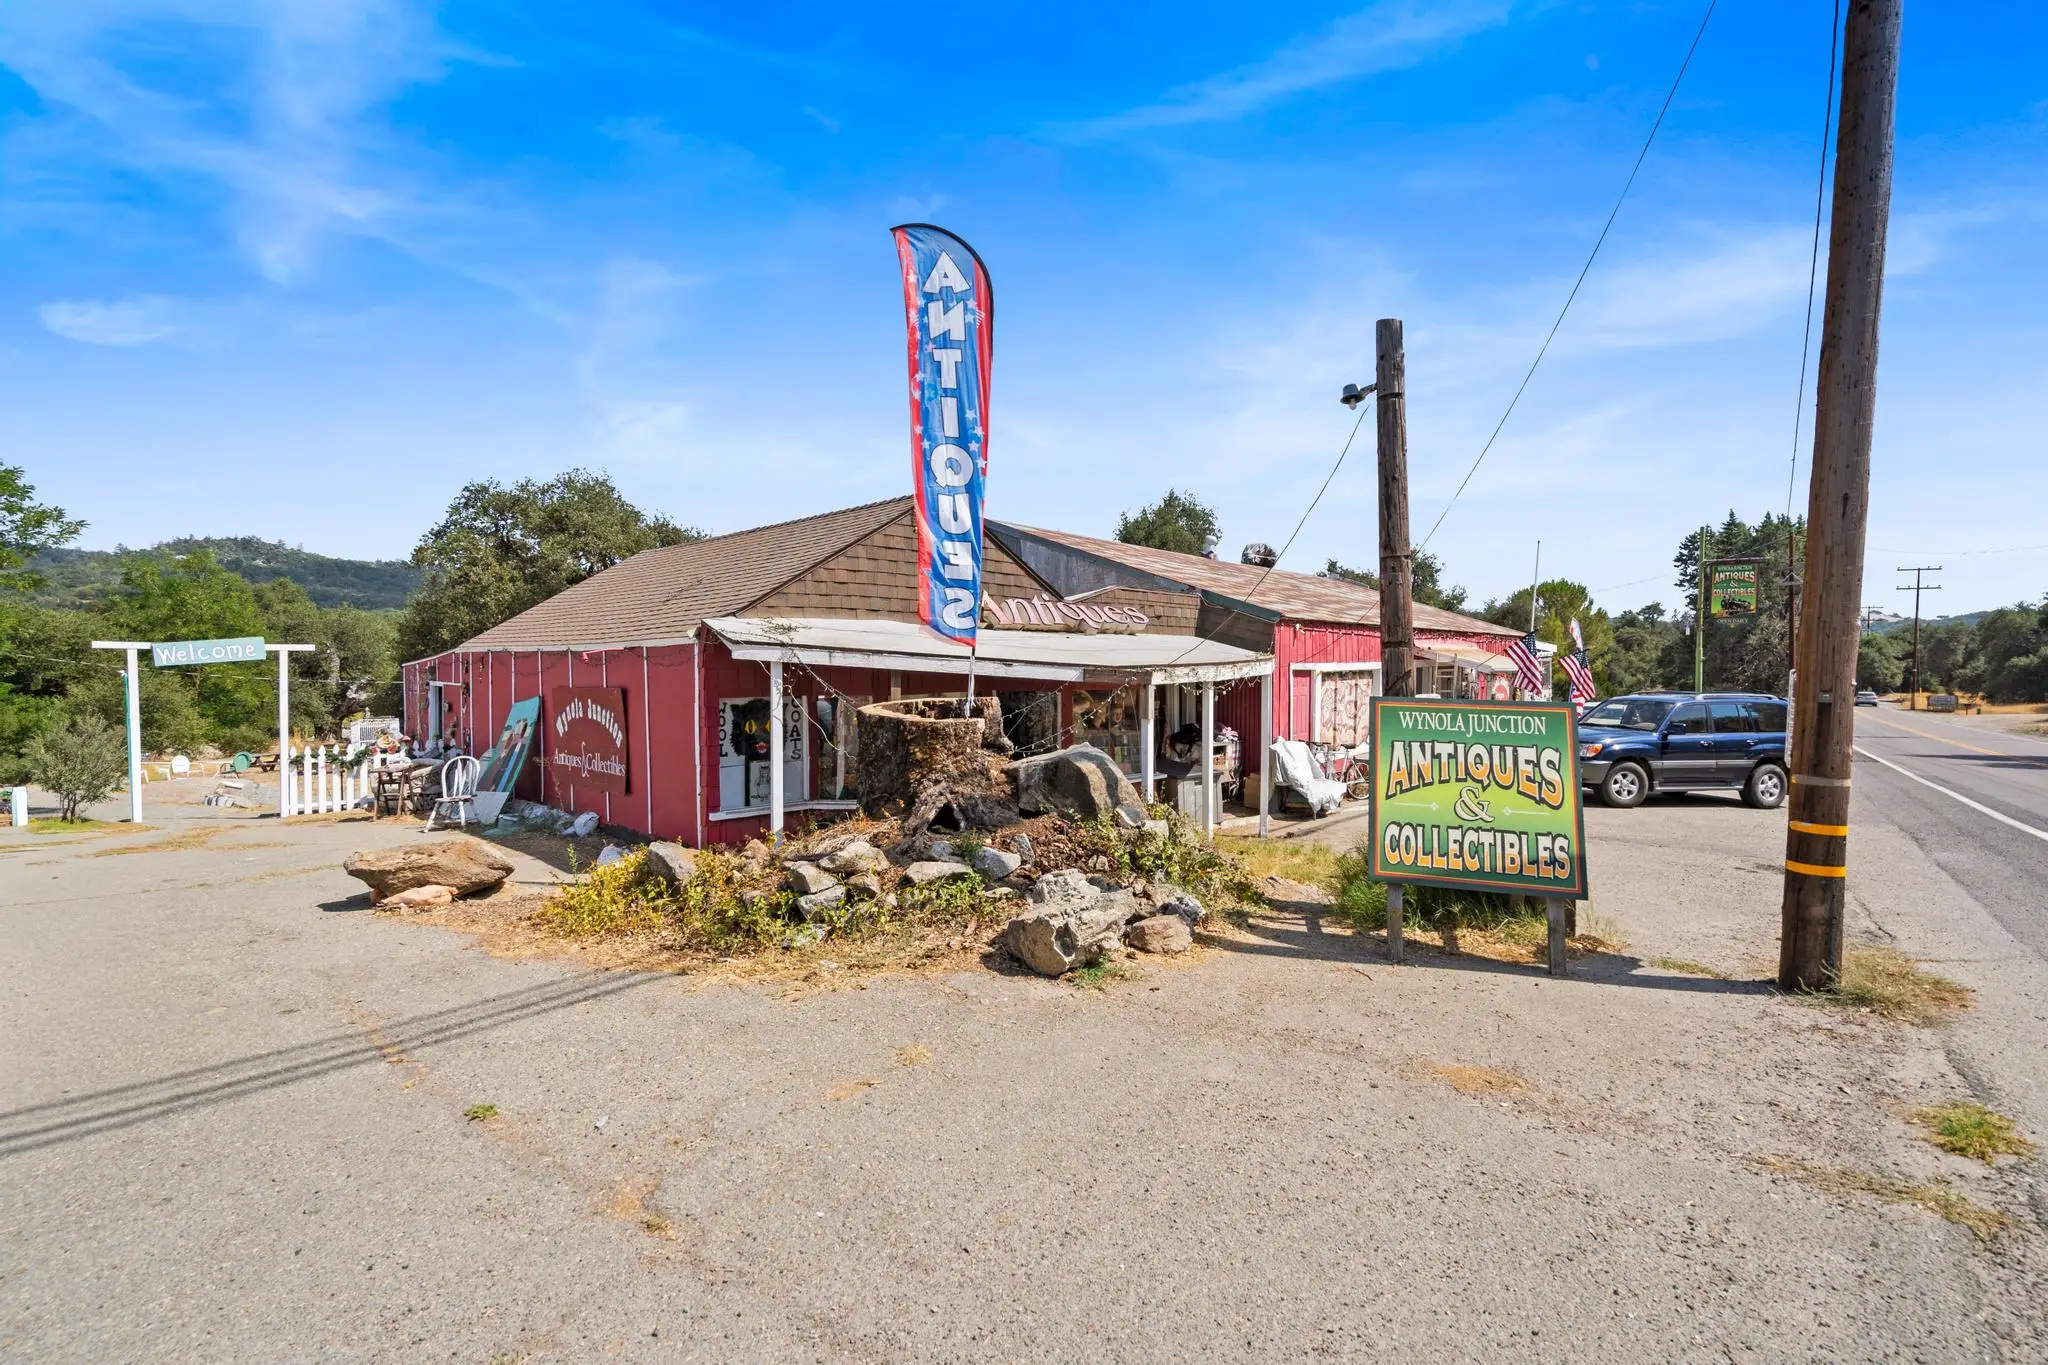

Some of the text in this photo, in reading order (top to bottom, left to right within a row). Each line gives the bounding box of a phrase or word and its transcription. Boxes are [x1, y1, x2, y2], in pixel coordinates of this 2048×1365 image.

[1714, 571, 1755, 583] ANTIQUES
[980, 589, 1149, 630] Antiques
[156, 643, 257, 664] Welcome
[1399, 711, 1546, 738] WYNOLA JUNCTION
[553, 747, 581, 771] Antiques
[586, 752, 626, 777] Collectibles
[1386, 740, 1564, 809] ANTIQUES
[1454, 785, 1495, 822] &
[1384, 821, 1571, 880] COLLECTIBLES
